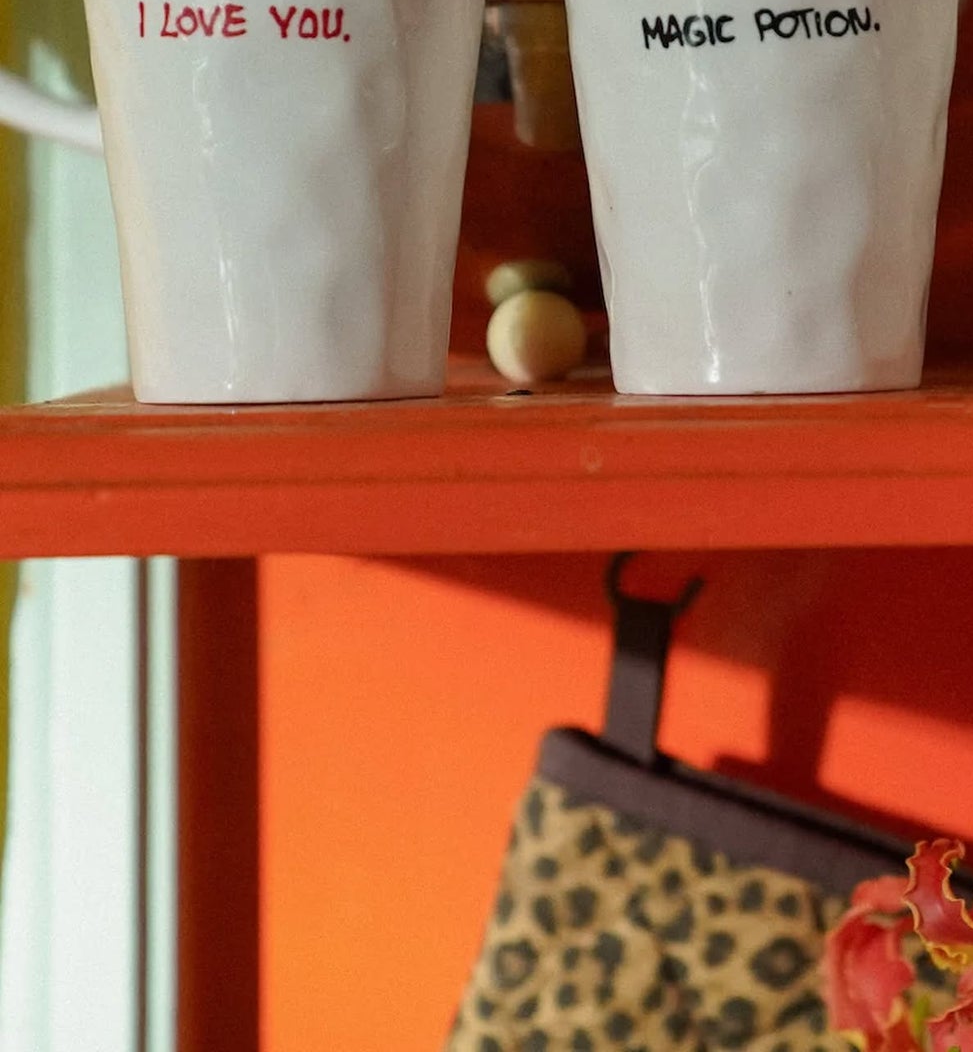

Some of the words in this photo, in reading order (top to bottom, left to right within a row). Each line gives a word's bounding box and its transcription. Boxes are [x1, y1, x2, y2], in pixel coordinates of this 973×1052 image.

[138, 1, 146, 38] I
[159, 2, 247, 39] LOVE
[268, 4, 351, 45] YOU.
[641, 14, 736, 50] MAGIC
[753, 6, 881, 43] POTION.
